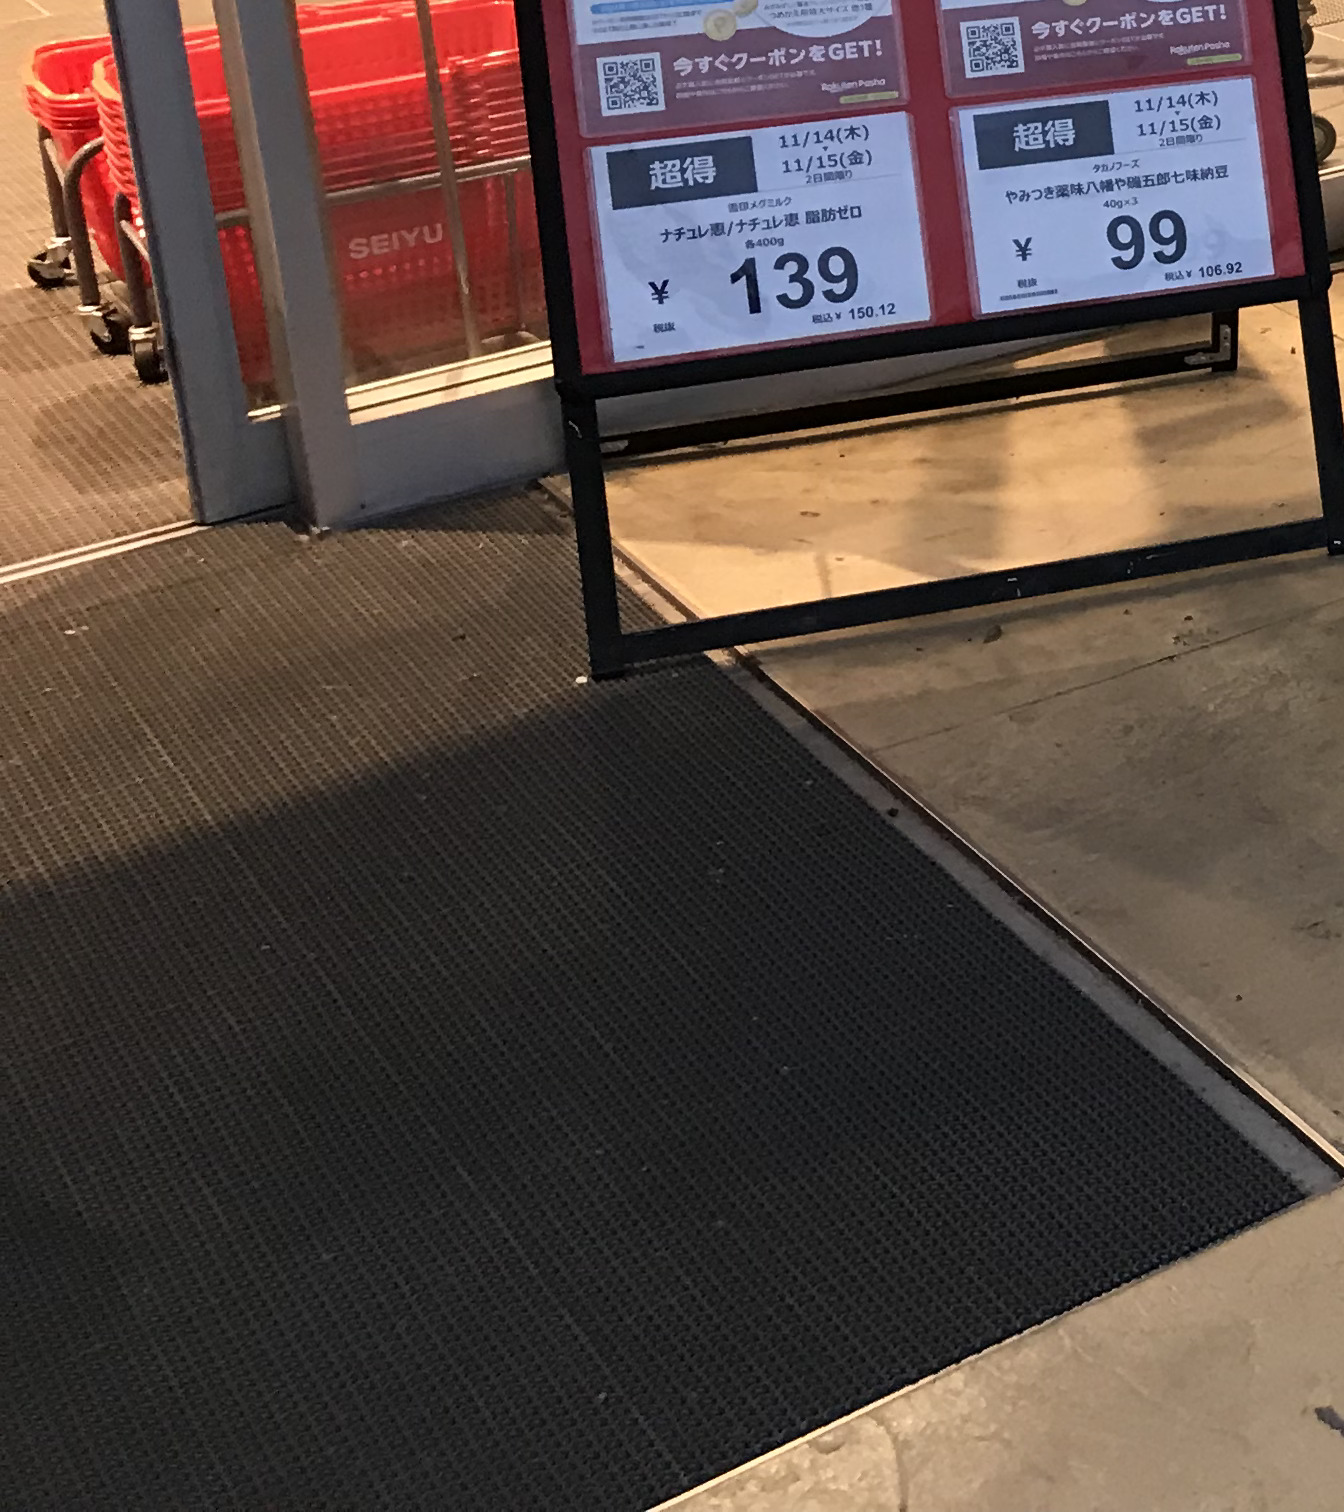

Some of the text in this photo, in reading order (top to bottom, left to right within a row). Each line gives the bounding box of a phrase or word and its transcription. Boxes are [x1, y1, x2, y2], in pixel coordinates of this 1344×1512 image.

[1031, 4, 1227, 40] 今すぐクーポンをGET!
[672, 38, 883, 77] 今すぐクーポンをGET!
[1134, 90, 1219, 113] 11/14(木)
[778, 124, 869, 149] 11/14(木)
[1013, 118, 1076, 152] 超得
[1137, 114, 1221, 137] 11/15(金)
[649, 155, 717, 190] 超得
[782, 149, 873, 173] 11/15(金)
[1092, 159, 1140, 174] タカノフーズ
[805, 205, 862, 224] 脂肪ゼロ
[348, 222, 444, 261] SEIYU
[1012, 209, 1187, 270] ¥ 99
[648, 246, 859, 315] ¥ 139
[1198, 262, 1243, 279] 106.92
[848, 303, 896, 319] 150.12
